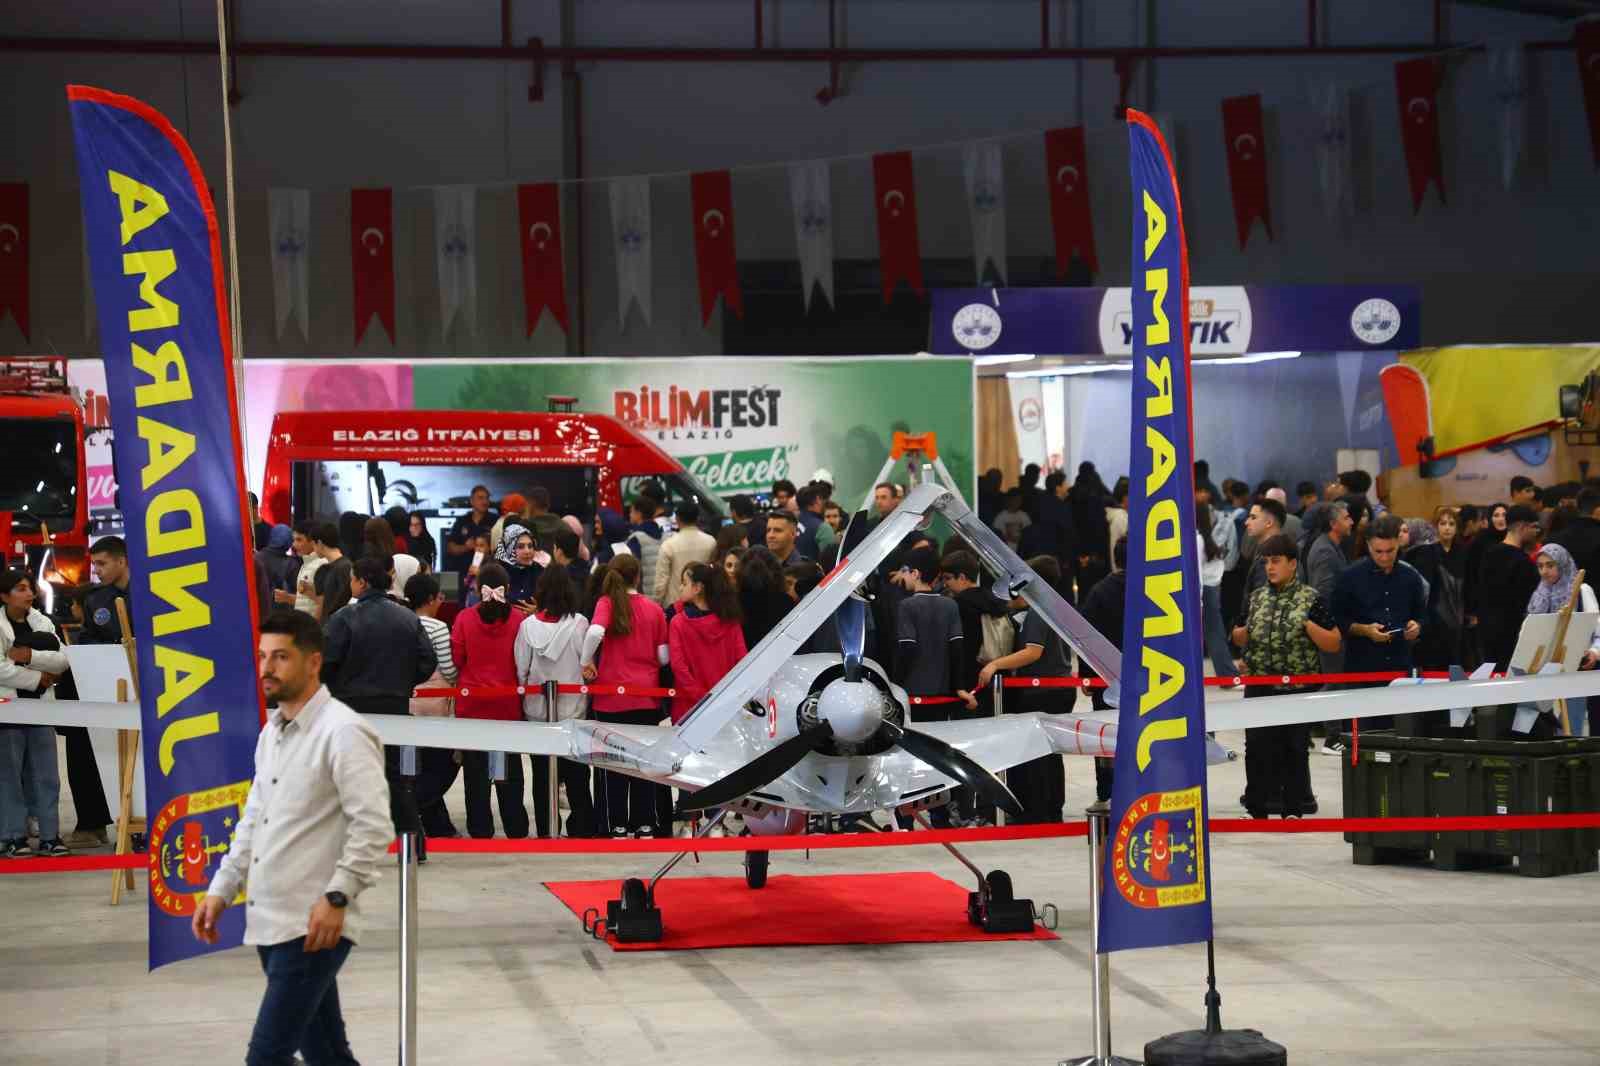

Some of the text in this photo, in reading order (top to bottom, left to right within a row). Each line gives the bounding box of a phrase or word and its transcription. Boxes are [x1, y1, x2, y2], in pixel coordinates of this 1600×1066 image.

[333, 427, 540, 441] ELAZIĞ İTFAİYESİ
[658, 429, 733, 439] ELAZIĞ
